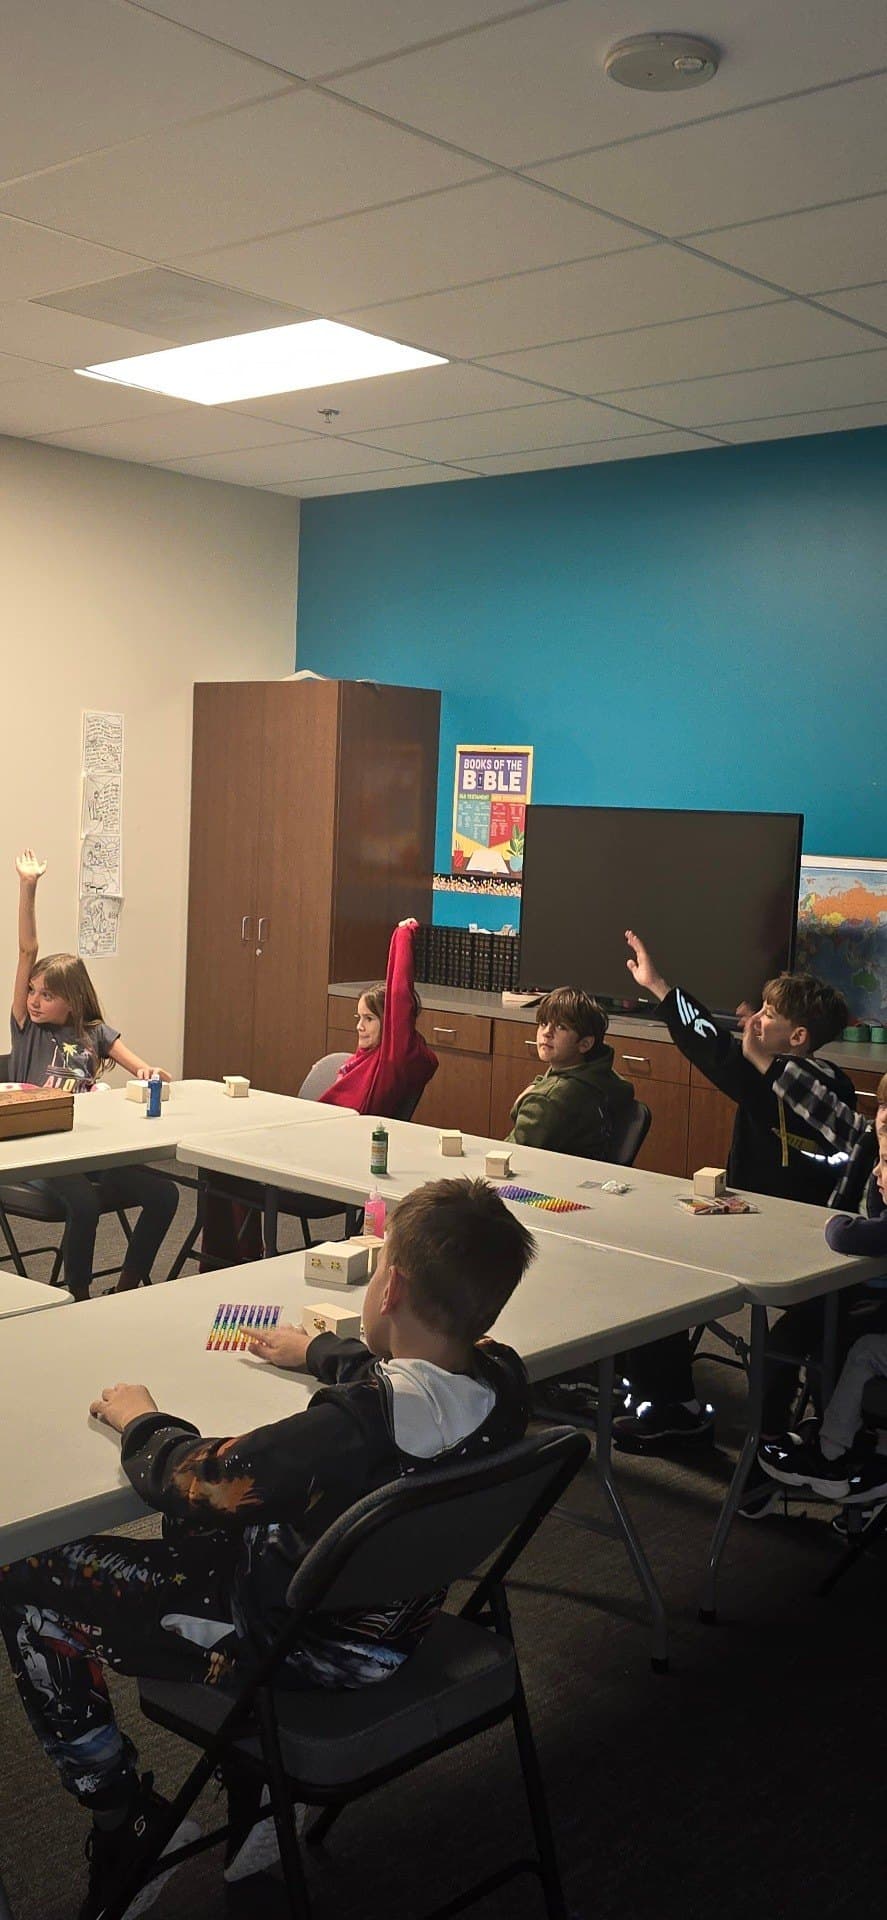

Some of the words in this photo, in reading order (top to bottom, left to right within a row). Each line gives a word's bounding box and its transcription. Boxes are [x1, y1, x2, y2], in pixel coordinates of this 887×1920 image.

[464, 758, 492, 770] BOOKS
[493, 759, 505, 770] OF
[506, 759, 523, 771] THE
